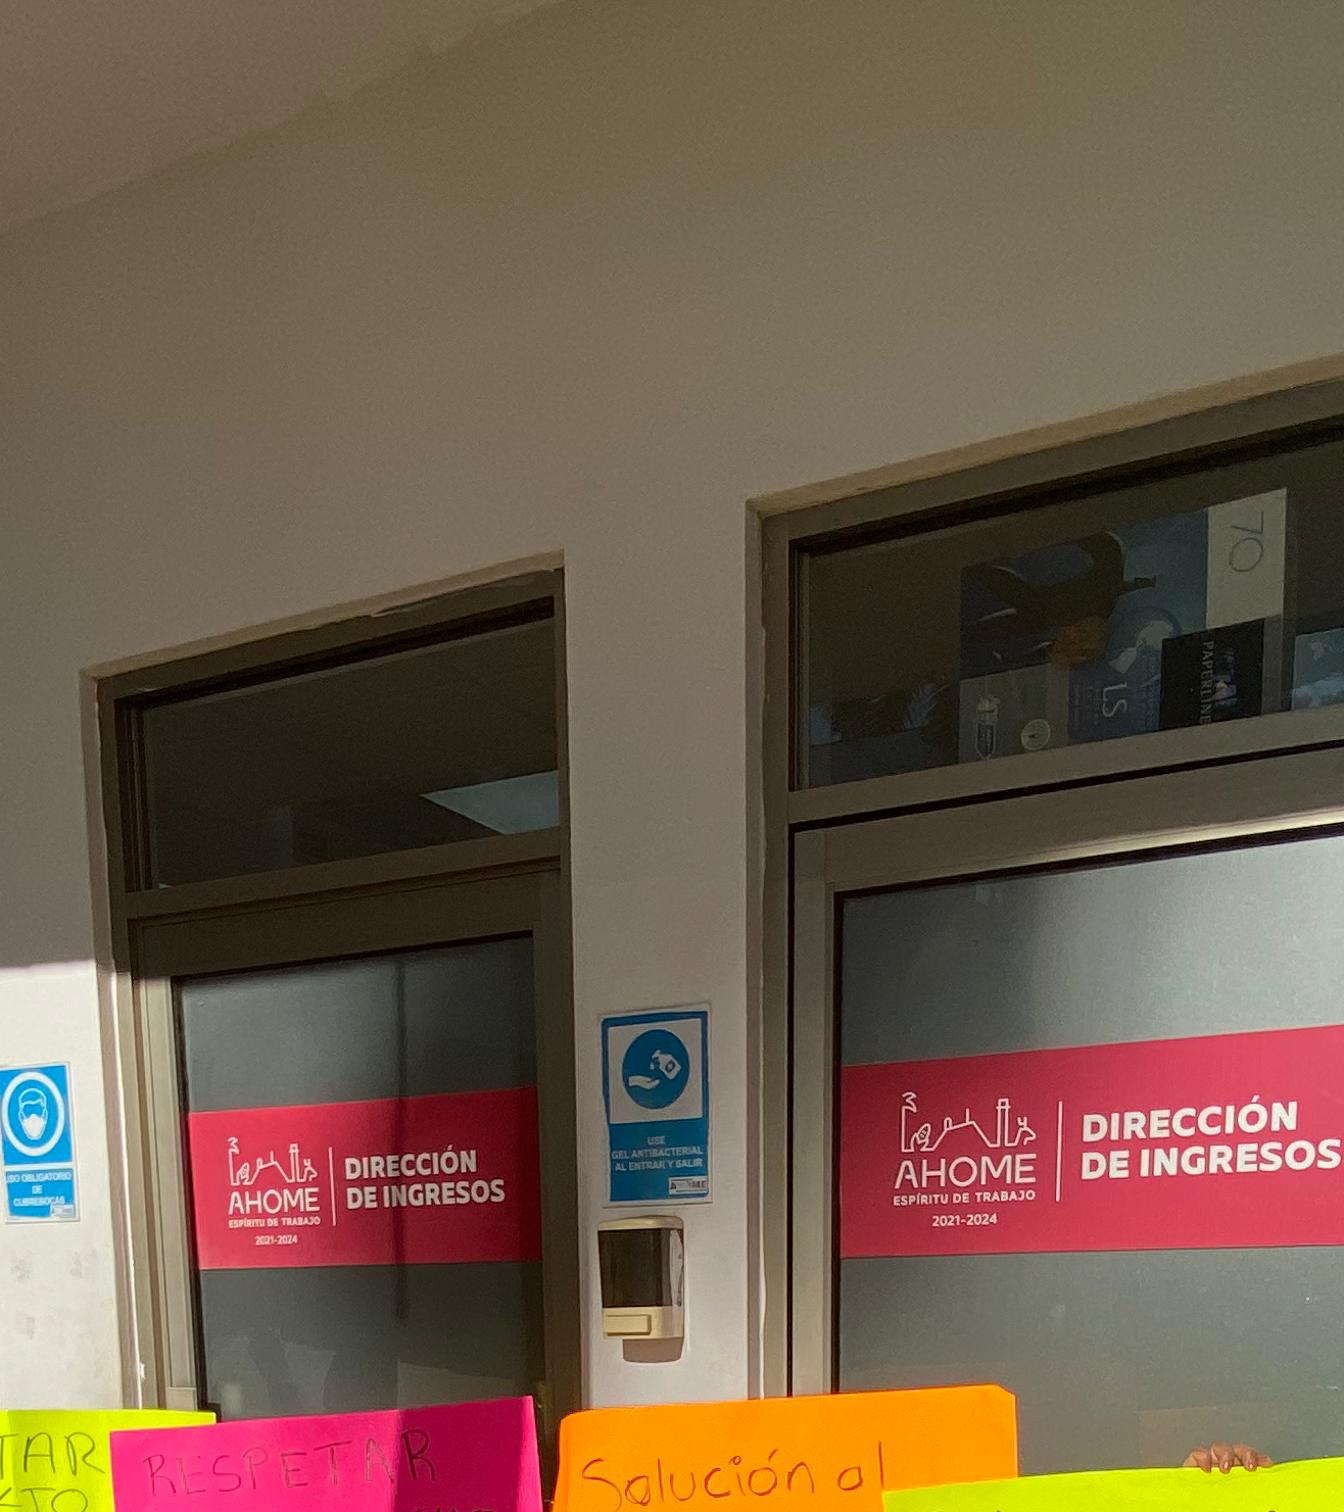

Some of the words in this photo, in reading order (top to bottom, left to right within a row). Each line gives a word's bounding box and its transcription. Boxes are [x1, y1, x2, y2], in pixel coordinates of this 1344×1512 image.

[1228, 510, 1264, 572] 70
[1199, 640, 1214, 724] PAPERLINE
[1082, 1094, 1297, 1141] DIRECCIÓN
[344, 1144, 477, 1180] DIRECCIÓN
[894, 1152, 1037, 1189] AHOME
[1081, 1149, 1129, 1180] DE
[1140, 1139, 1342, 1178] INGRESOS
[228, 1187, 321, 1215] AHOME
[345, 1189, 378, 1211] DE
[383, 1179, 505, 1209] INGRESOS
[892, 1190, 950, 1206] ESPÍRITU
[952, 1191, 971, 1204] DE
[974, 1188, 1036, 1203] TRABAJO
[931, 1212, 998, 1227] 2021-2024
[143, 1428, 437, 1498] RESPETAR
[837, 1440, 887, 1491] al
